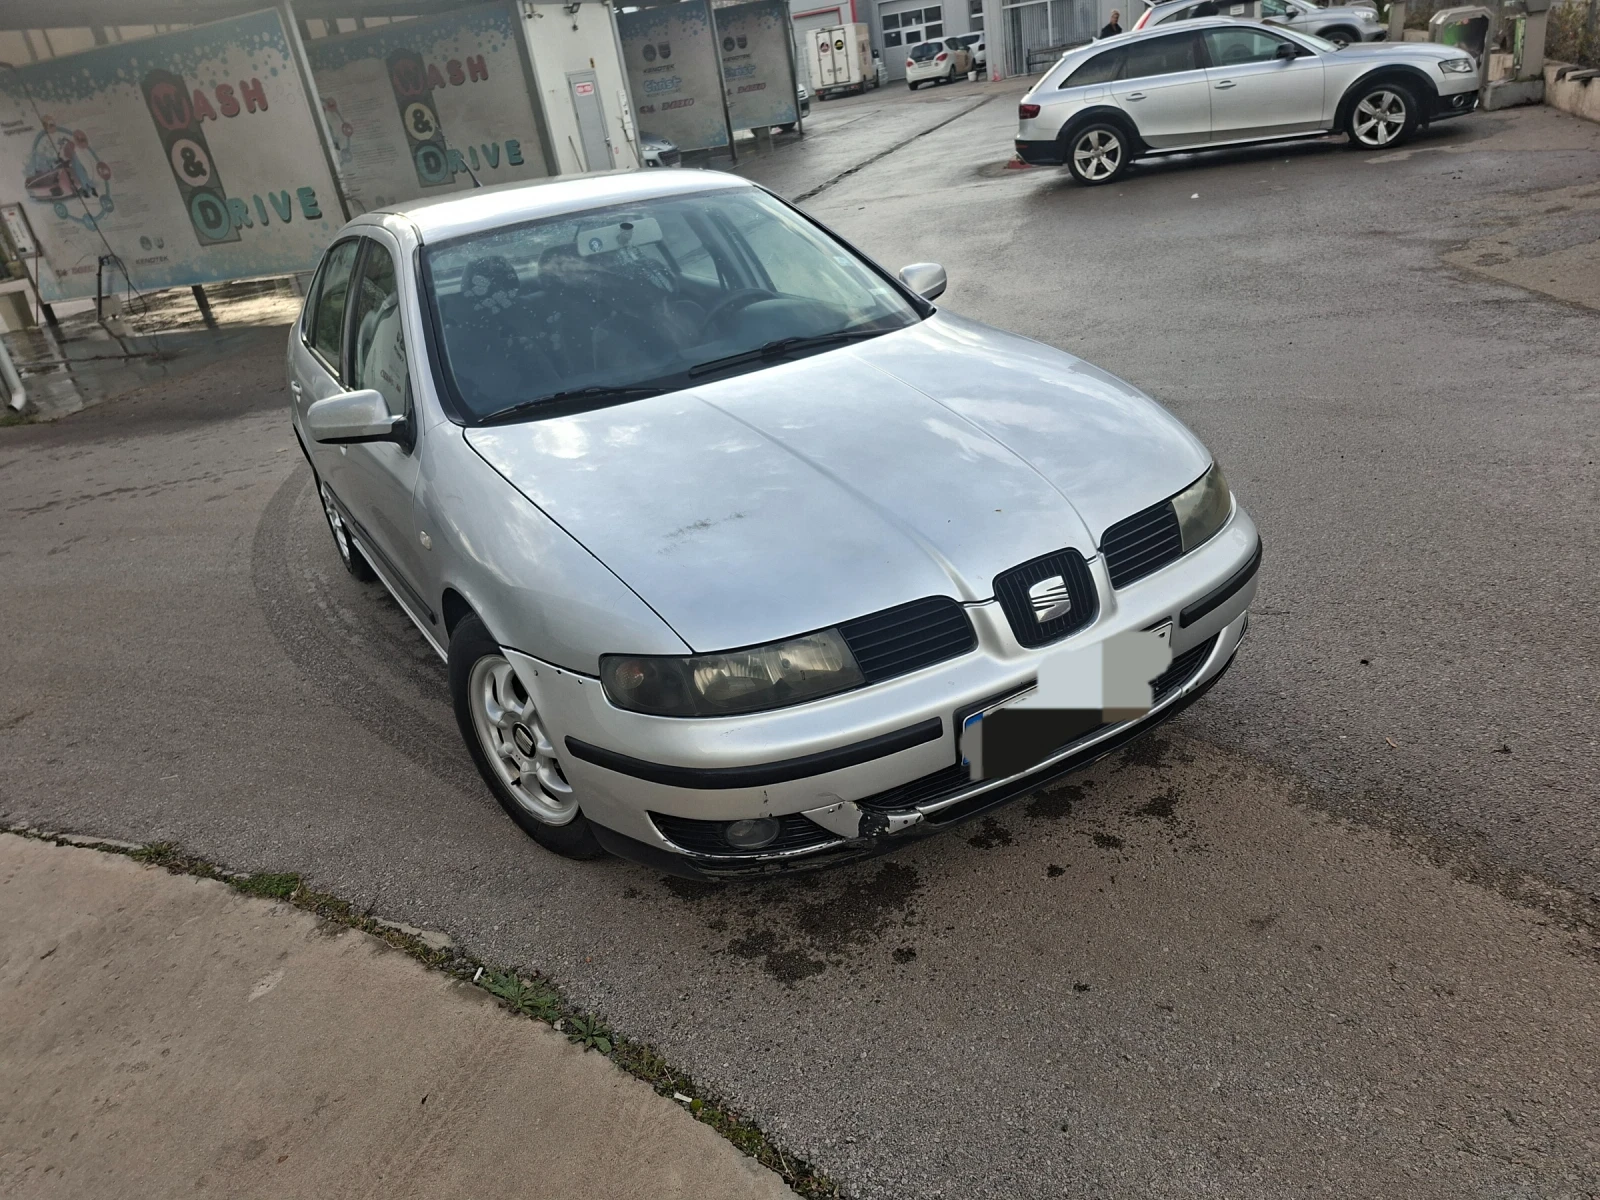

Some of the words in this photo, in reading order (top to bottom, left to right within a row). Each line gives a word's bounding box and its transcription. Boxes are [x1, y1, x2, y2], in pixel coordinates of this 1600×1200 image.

[396, 54, 488, 93] WASH
[153, 77, 269, 126] WASH
[412, 108, 433, 133] &
[180, 147, 207, 178] &
[422, 139, 524, 175] DRIVE
[198, 186, 322, 230] DRIVE
